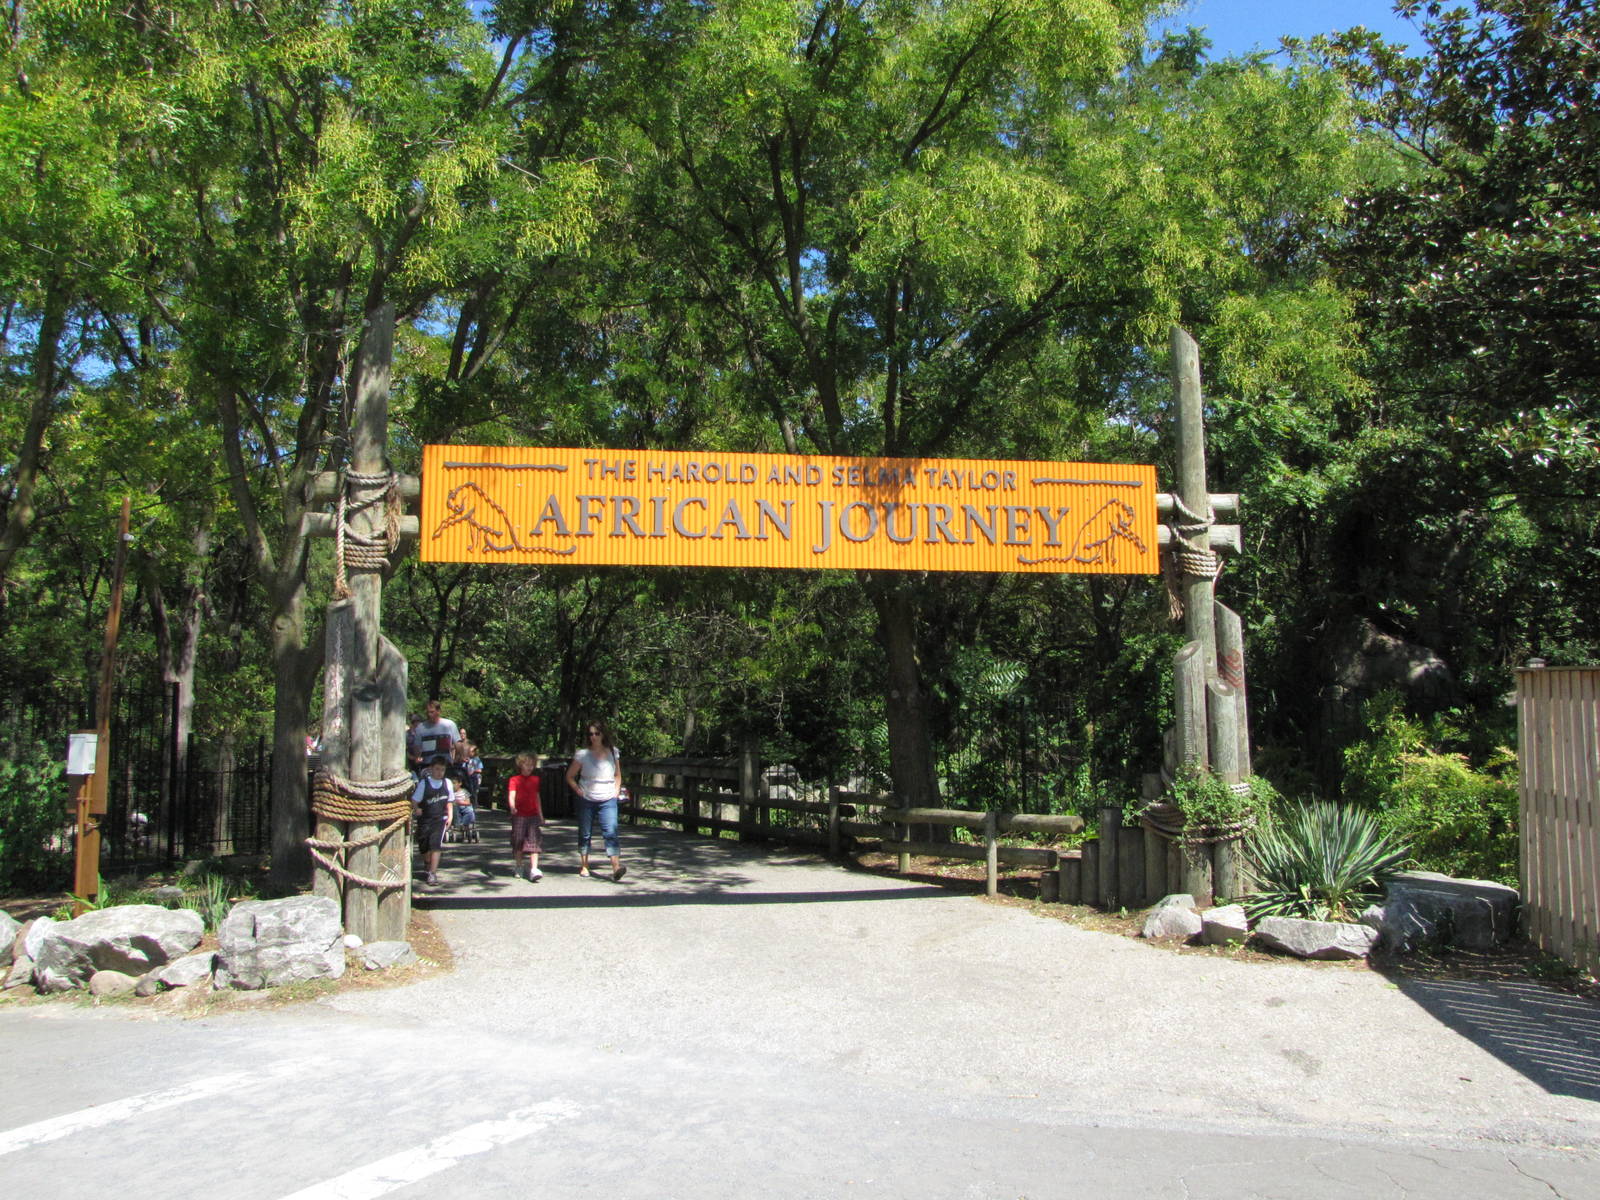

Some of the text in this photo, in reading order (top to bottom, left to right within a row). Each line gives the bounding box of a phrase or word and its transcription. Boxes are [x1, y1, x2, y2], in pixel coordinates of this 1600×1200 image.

[584, 458, 1017, 491] THE HAROLD AND SELMA TAYLOR
[529, 494, 1071, 554] AFRICAN JOURNEY
